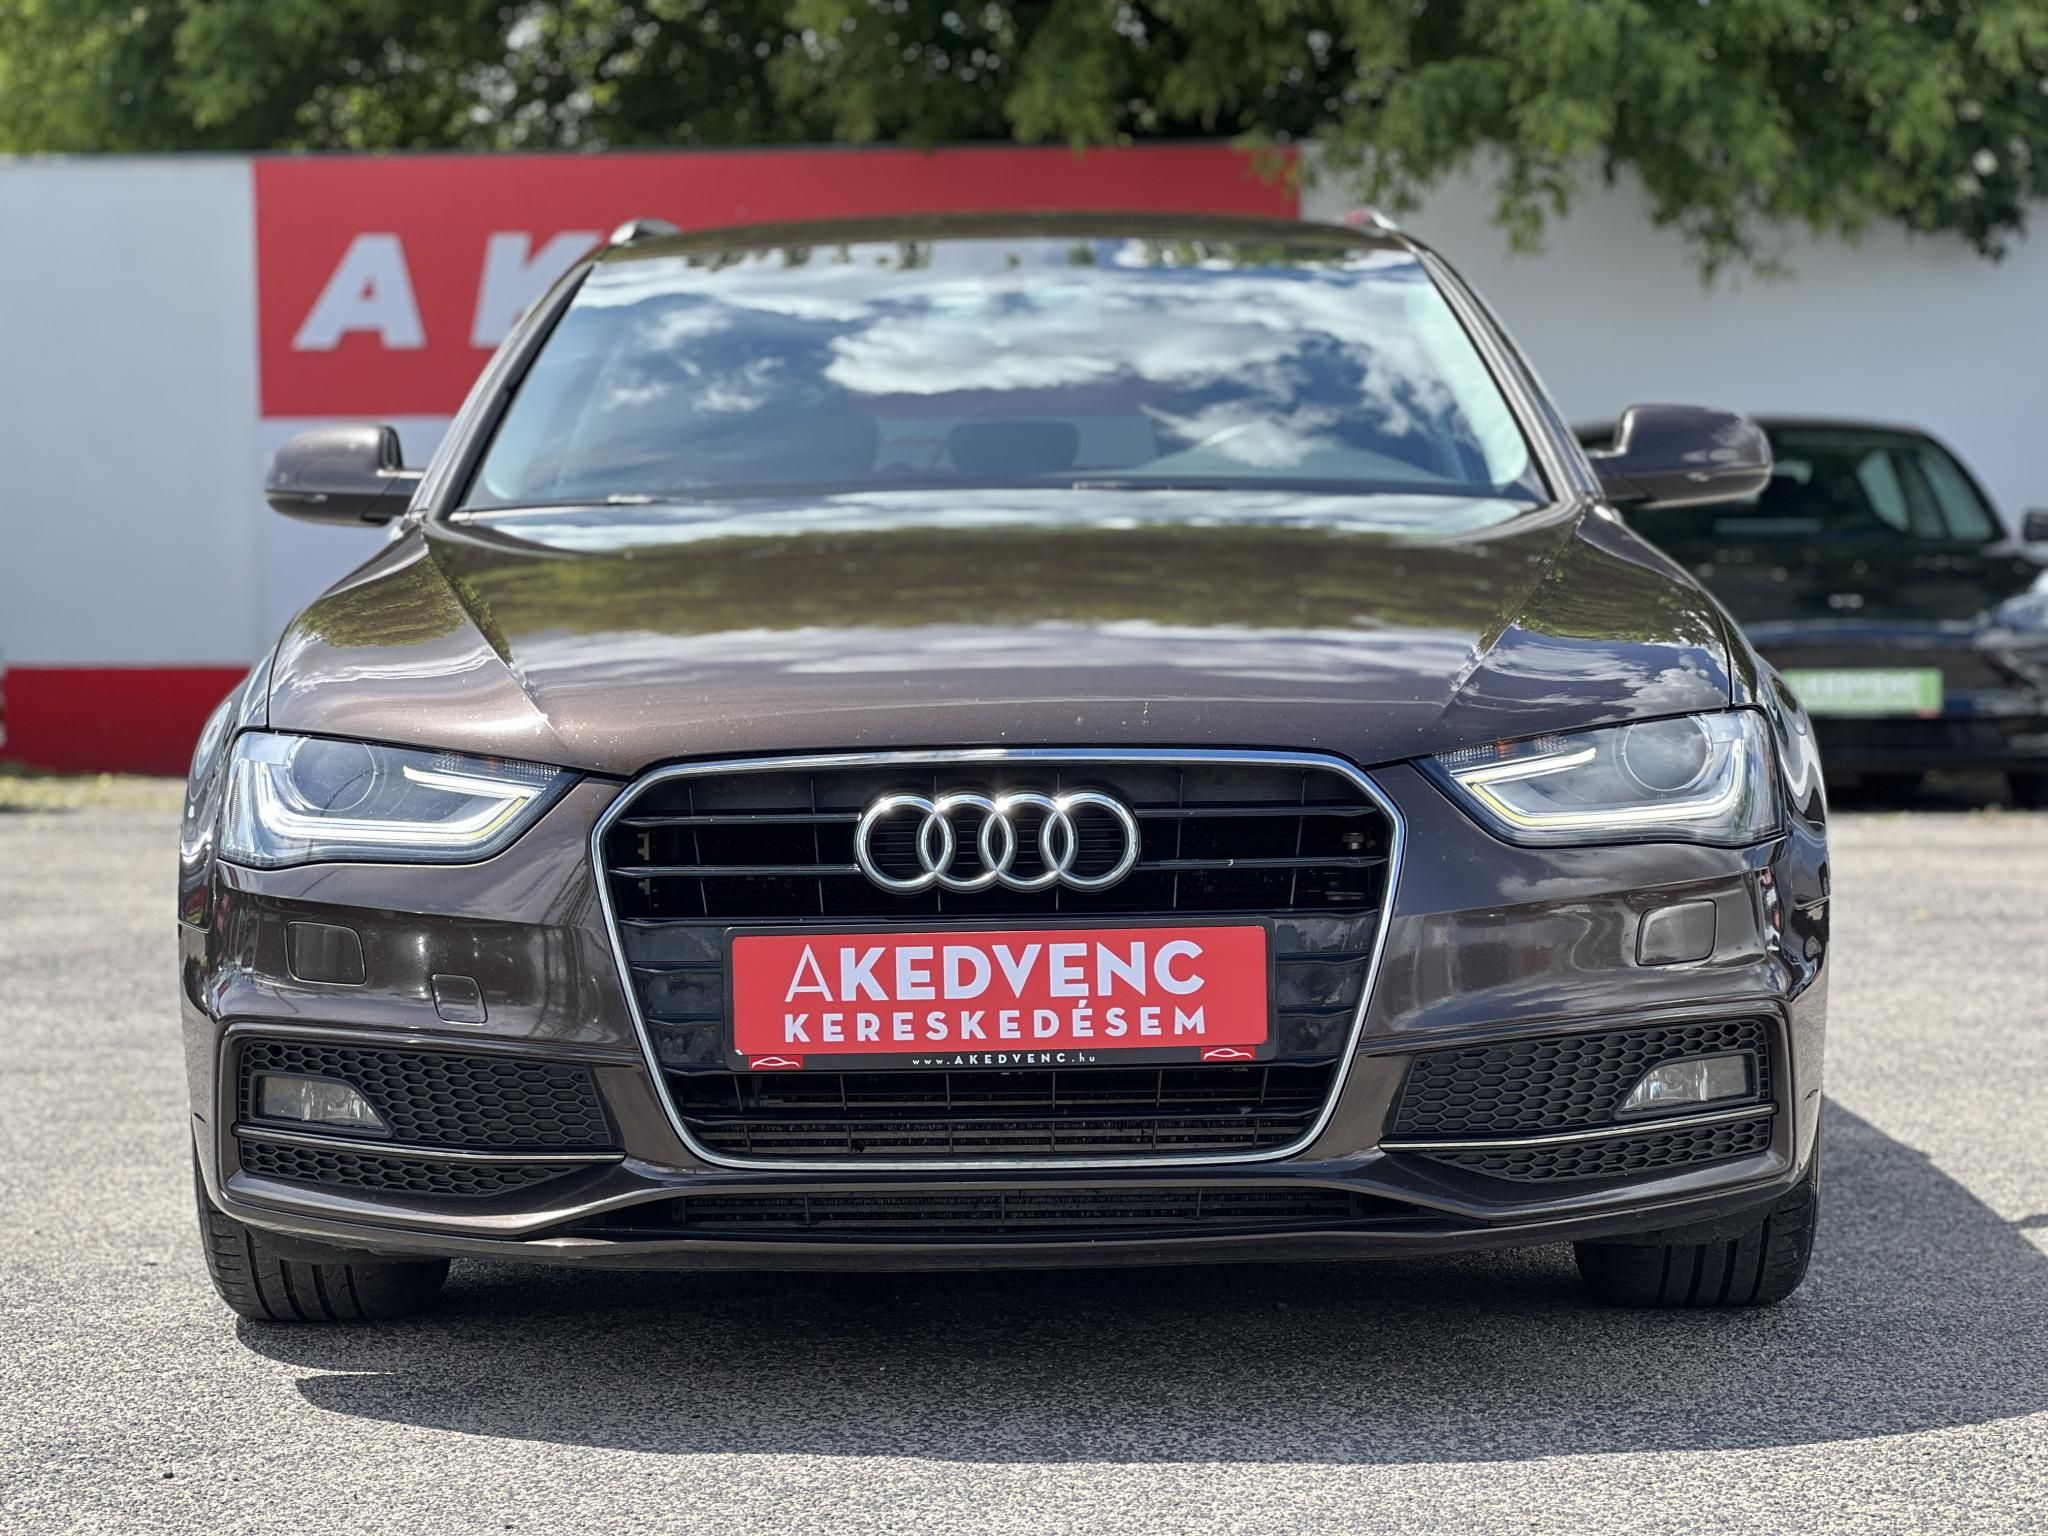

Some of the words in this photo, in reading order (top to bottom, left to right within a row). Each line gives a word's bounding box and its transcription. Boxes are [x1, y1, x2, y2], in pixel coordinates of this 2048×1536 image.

[785, 939, 1205, 1003] AKEDVENC
[784, 999, 1206, 1043] KERESKEDÉSEM
[912, 1052, 1096, 1066] www.AKEDVENC.hu
